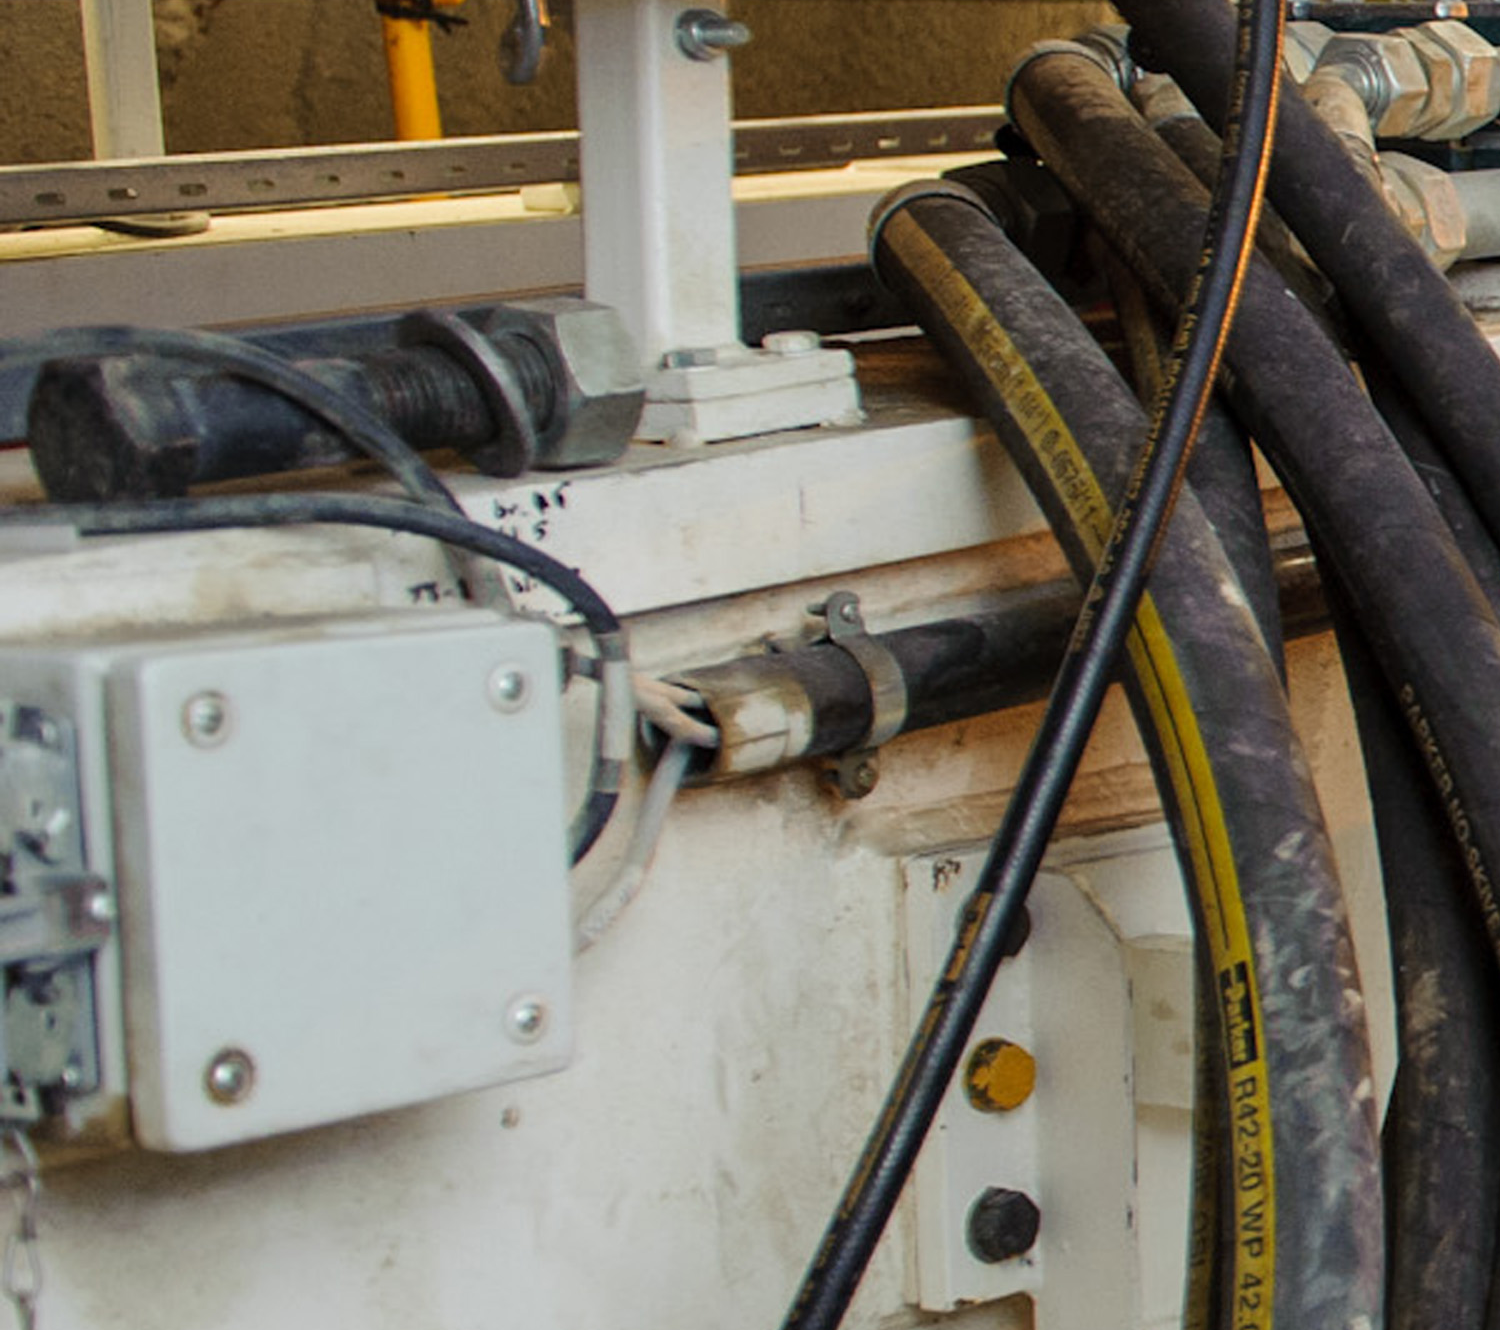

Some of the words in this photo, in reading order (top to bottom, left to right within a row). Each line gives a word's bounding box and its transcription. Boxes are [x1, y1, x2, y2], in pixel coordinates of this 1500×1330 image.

[1220, 982, 1254, 1064] Parker
[1232, 1075, 1263, 1192] R42-20
[1240, 1200, 1266, 1257] WP
